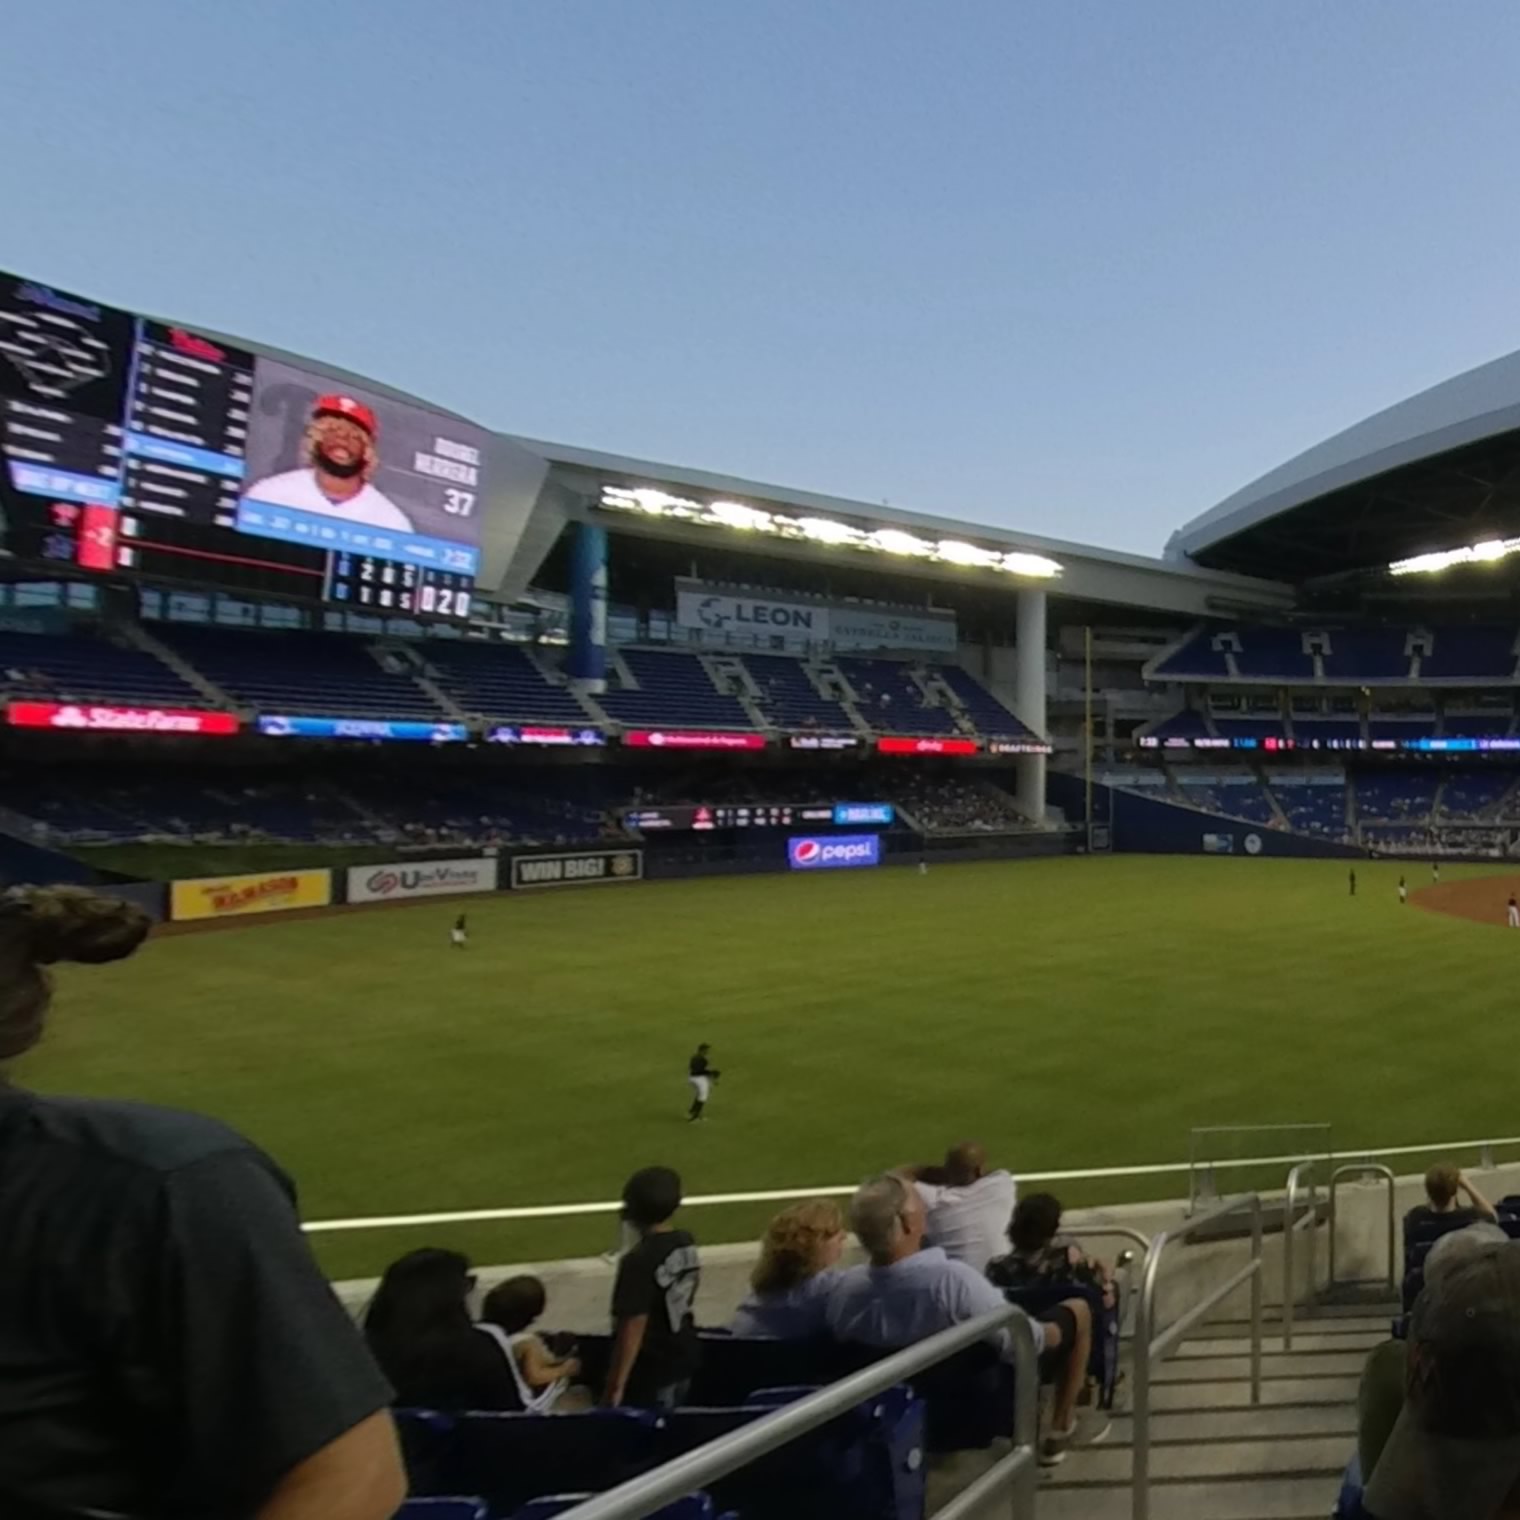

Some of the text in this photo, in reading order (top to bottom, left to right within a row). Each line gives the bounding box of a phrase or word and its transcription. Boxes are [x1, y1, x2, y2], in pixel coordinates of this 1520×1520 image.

[443, 488, 475, 517] 37
[736, 603, 812, 628] LEON
[822, 841, 872, 861] pepsi
[521, 857, 604, 881] WIN BIG!
